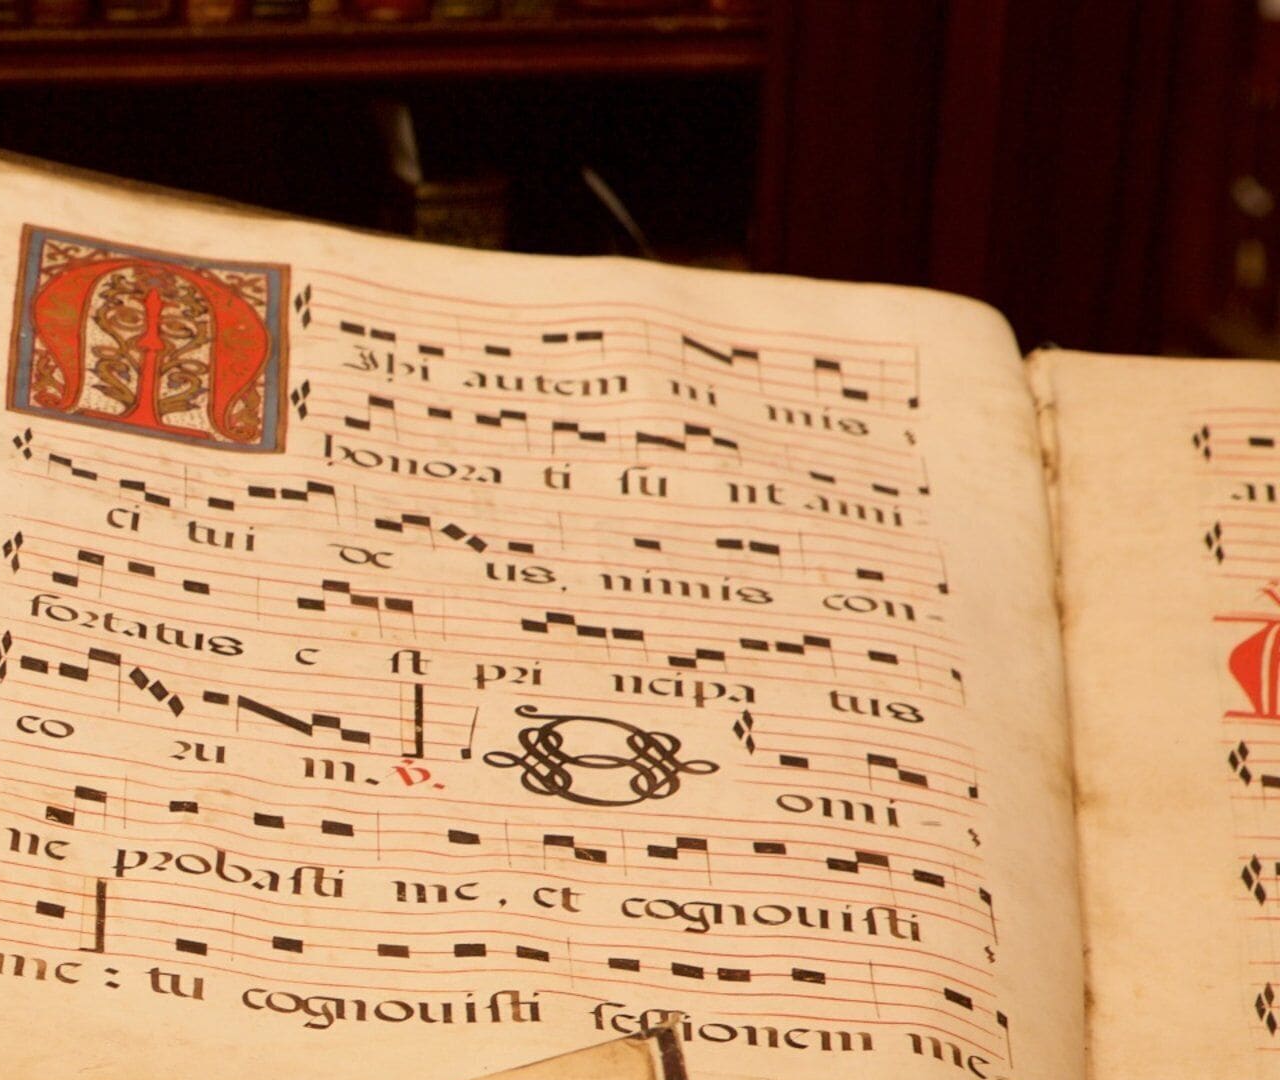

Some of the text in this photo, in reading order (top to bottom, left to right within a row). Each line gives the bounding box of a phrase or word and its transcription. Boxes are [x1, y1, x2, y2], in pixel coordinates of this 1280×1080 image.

[462, 371, 629, 398] autem
[767, 402, 870, 437] mis
[544, 463, 572, 490] ti
[728, 481, 784, 505] nt
[107, 504, 140, 533] ci
[188, 519, 256, 552] tui
[602, 570, 774, 606] nimis
[830, 690, 925, 724] tus
[16, 714, 75, 739] co
[5, 827, 70, 861] ne
[146, 966, 204, 1000] tu
